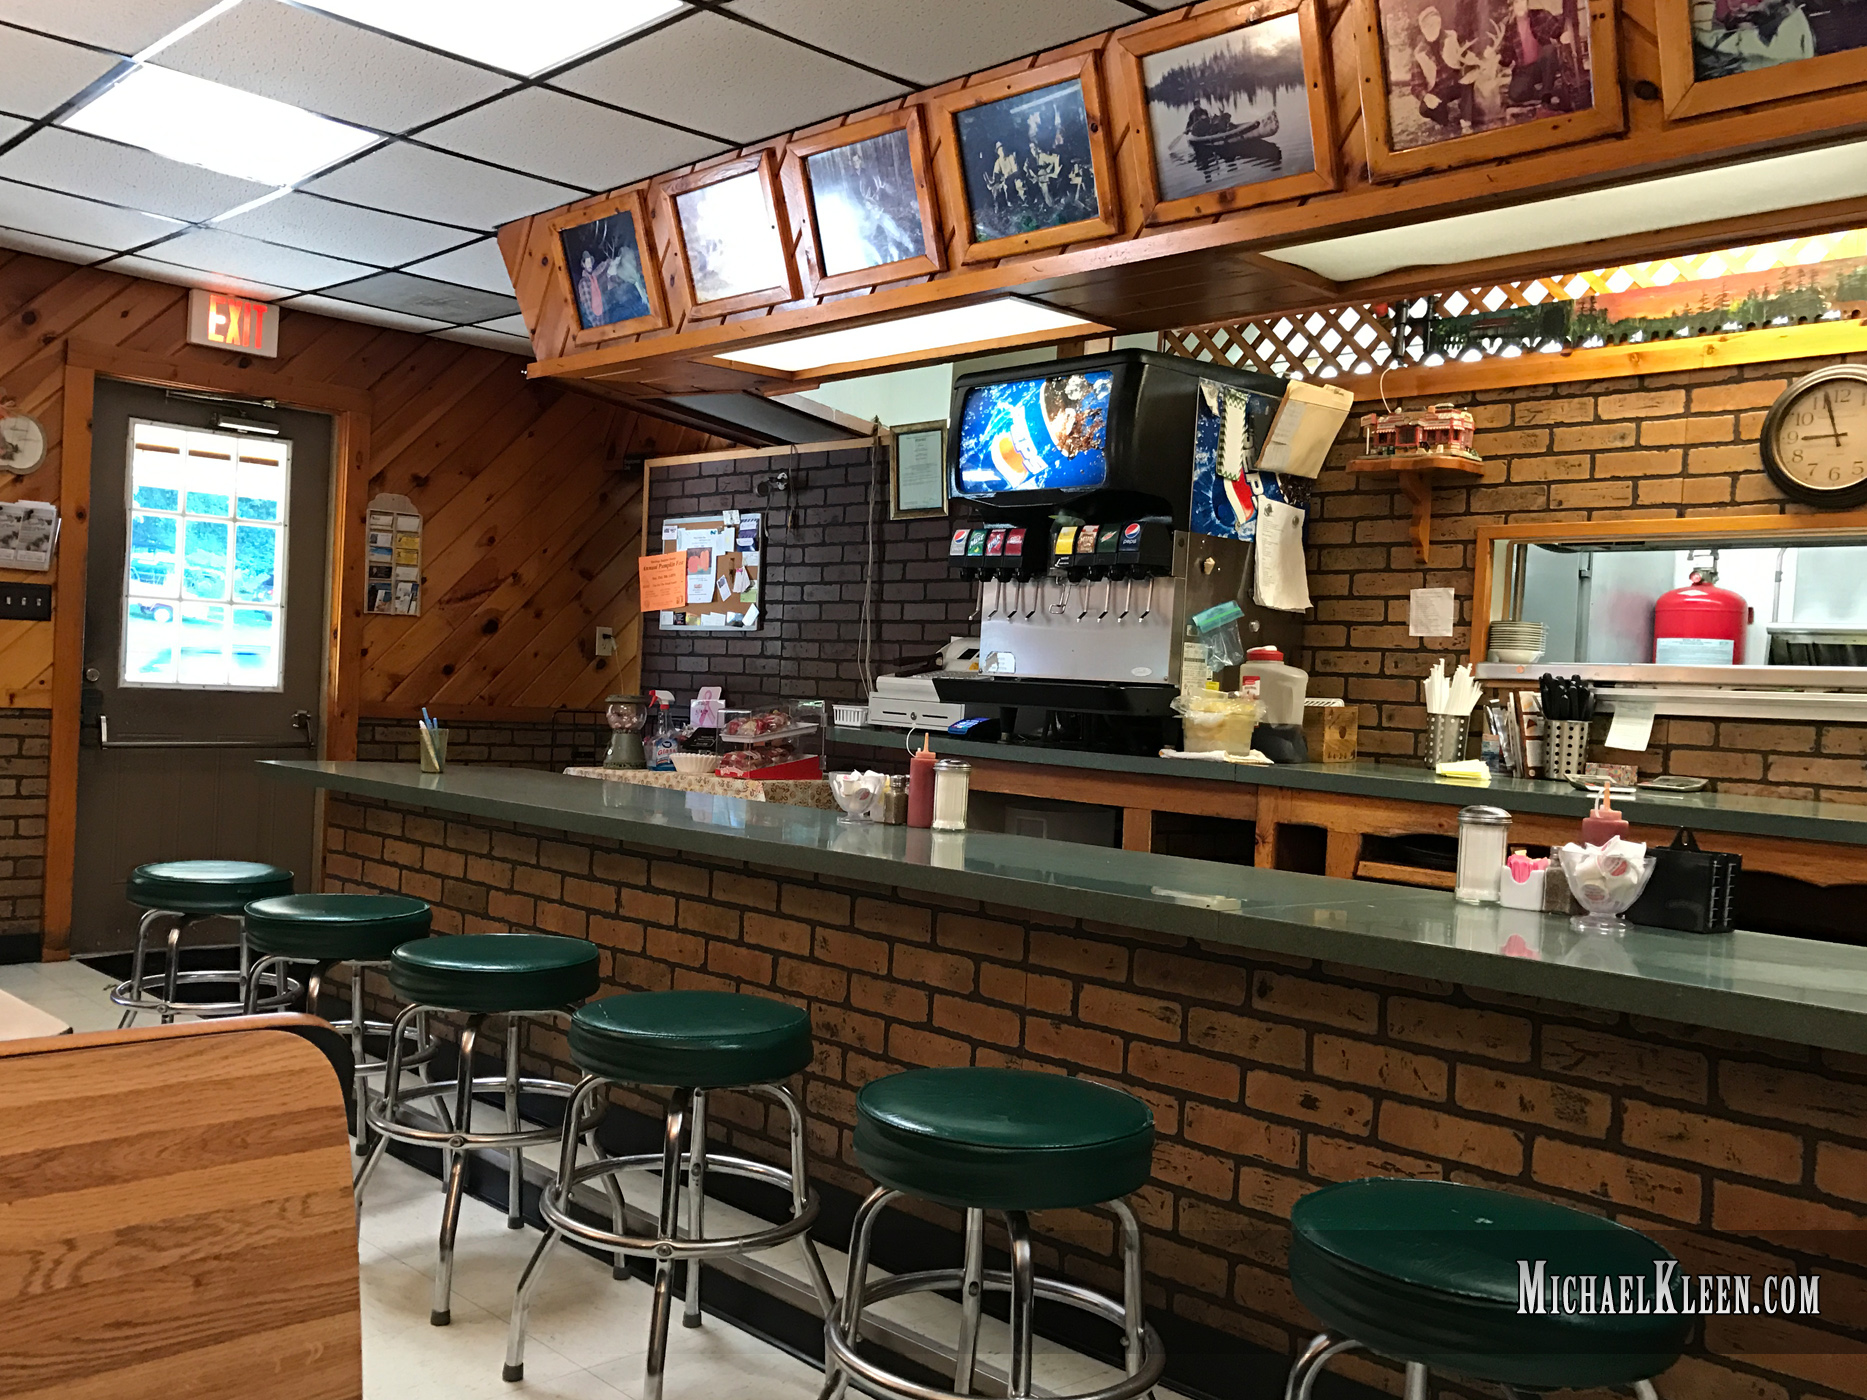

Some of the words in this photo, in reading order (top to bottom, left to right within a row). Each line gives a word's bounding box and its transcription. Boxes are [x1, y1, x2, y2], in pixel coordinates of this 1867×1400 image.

[207, 294, 268, 349] EXIT
[1834, 389, 1851, 403] 12
[1795, 412, 1814, 426] 10
[1787, 430, 1799, 445] 9
[1792, 449, 1804, 463] 8
[1807, 463, 1818, 477] 7
[1828, 467, 1841, 481] 6
[1851, 461, 1865, 475] 5
